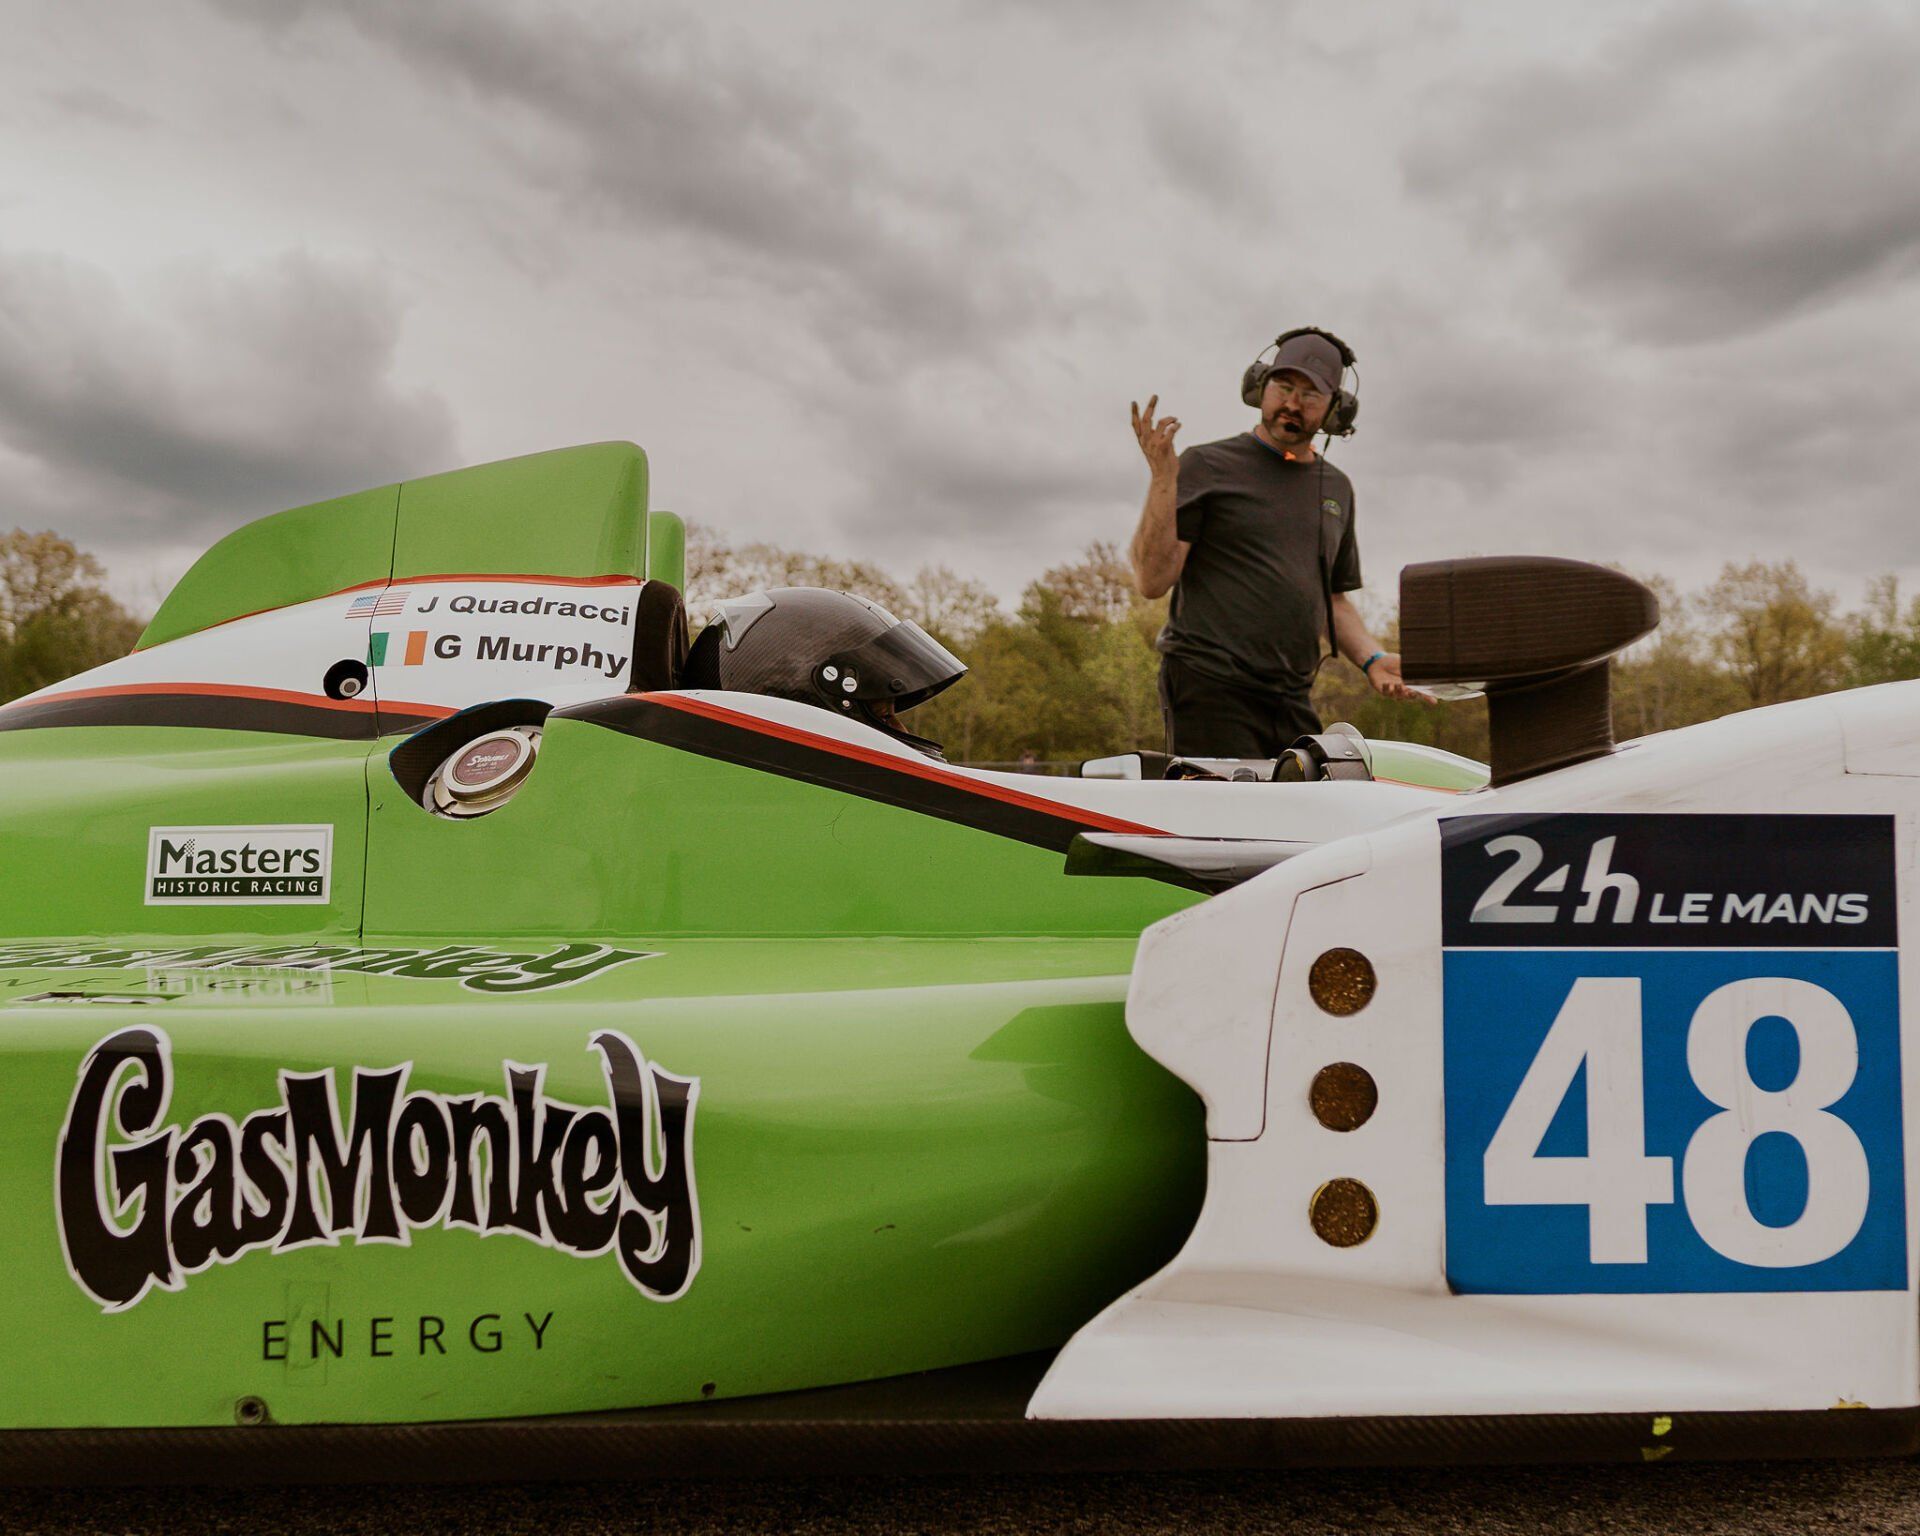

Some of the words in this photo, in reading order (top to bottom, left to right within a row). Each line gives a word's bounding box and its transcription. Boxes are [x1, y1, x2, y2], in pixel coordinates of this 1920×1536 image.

[417, 596, 440, 613] J
[449, 595, 630, 626] Quadracci
[433, 634, 462, 659] G
[476, 636, 629, 678] Murphy
[158, 838, 321, 874] Masters
[157, 880, 241, 894] HISTORIC
[251, 880, 319, 893] RACING
[1469, 834, 1640, 924] 24h
[1648, 893, 1715, 924] LE
[1721, 893, 1870, 924] MANS
[1483, 976, 1871, 1269] 48
[263, 1311, 555, 1362] ENERGY
